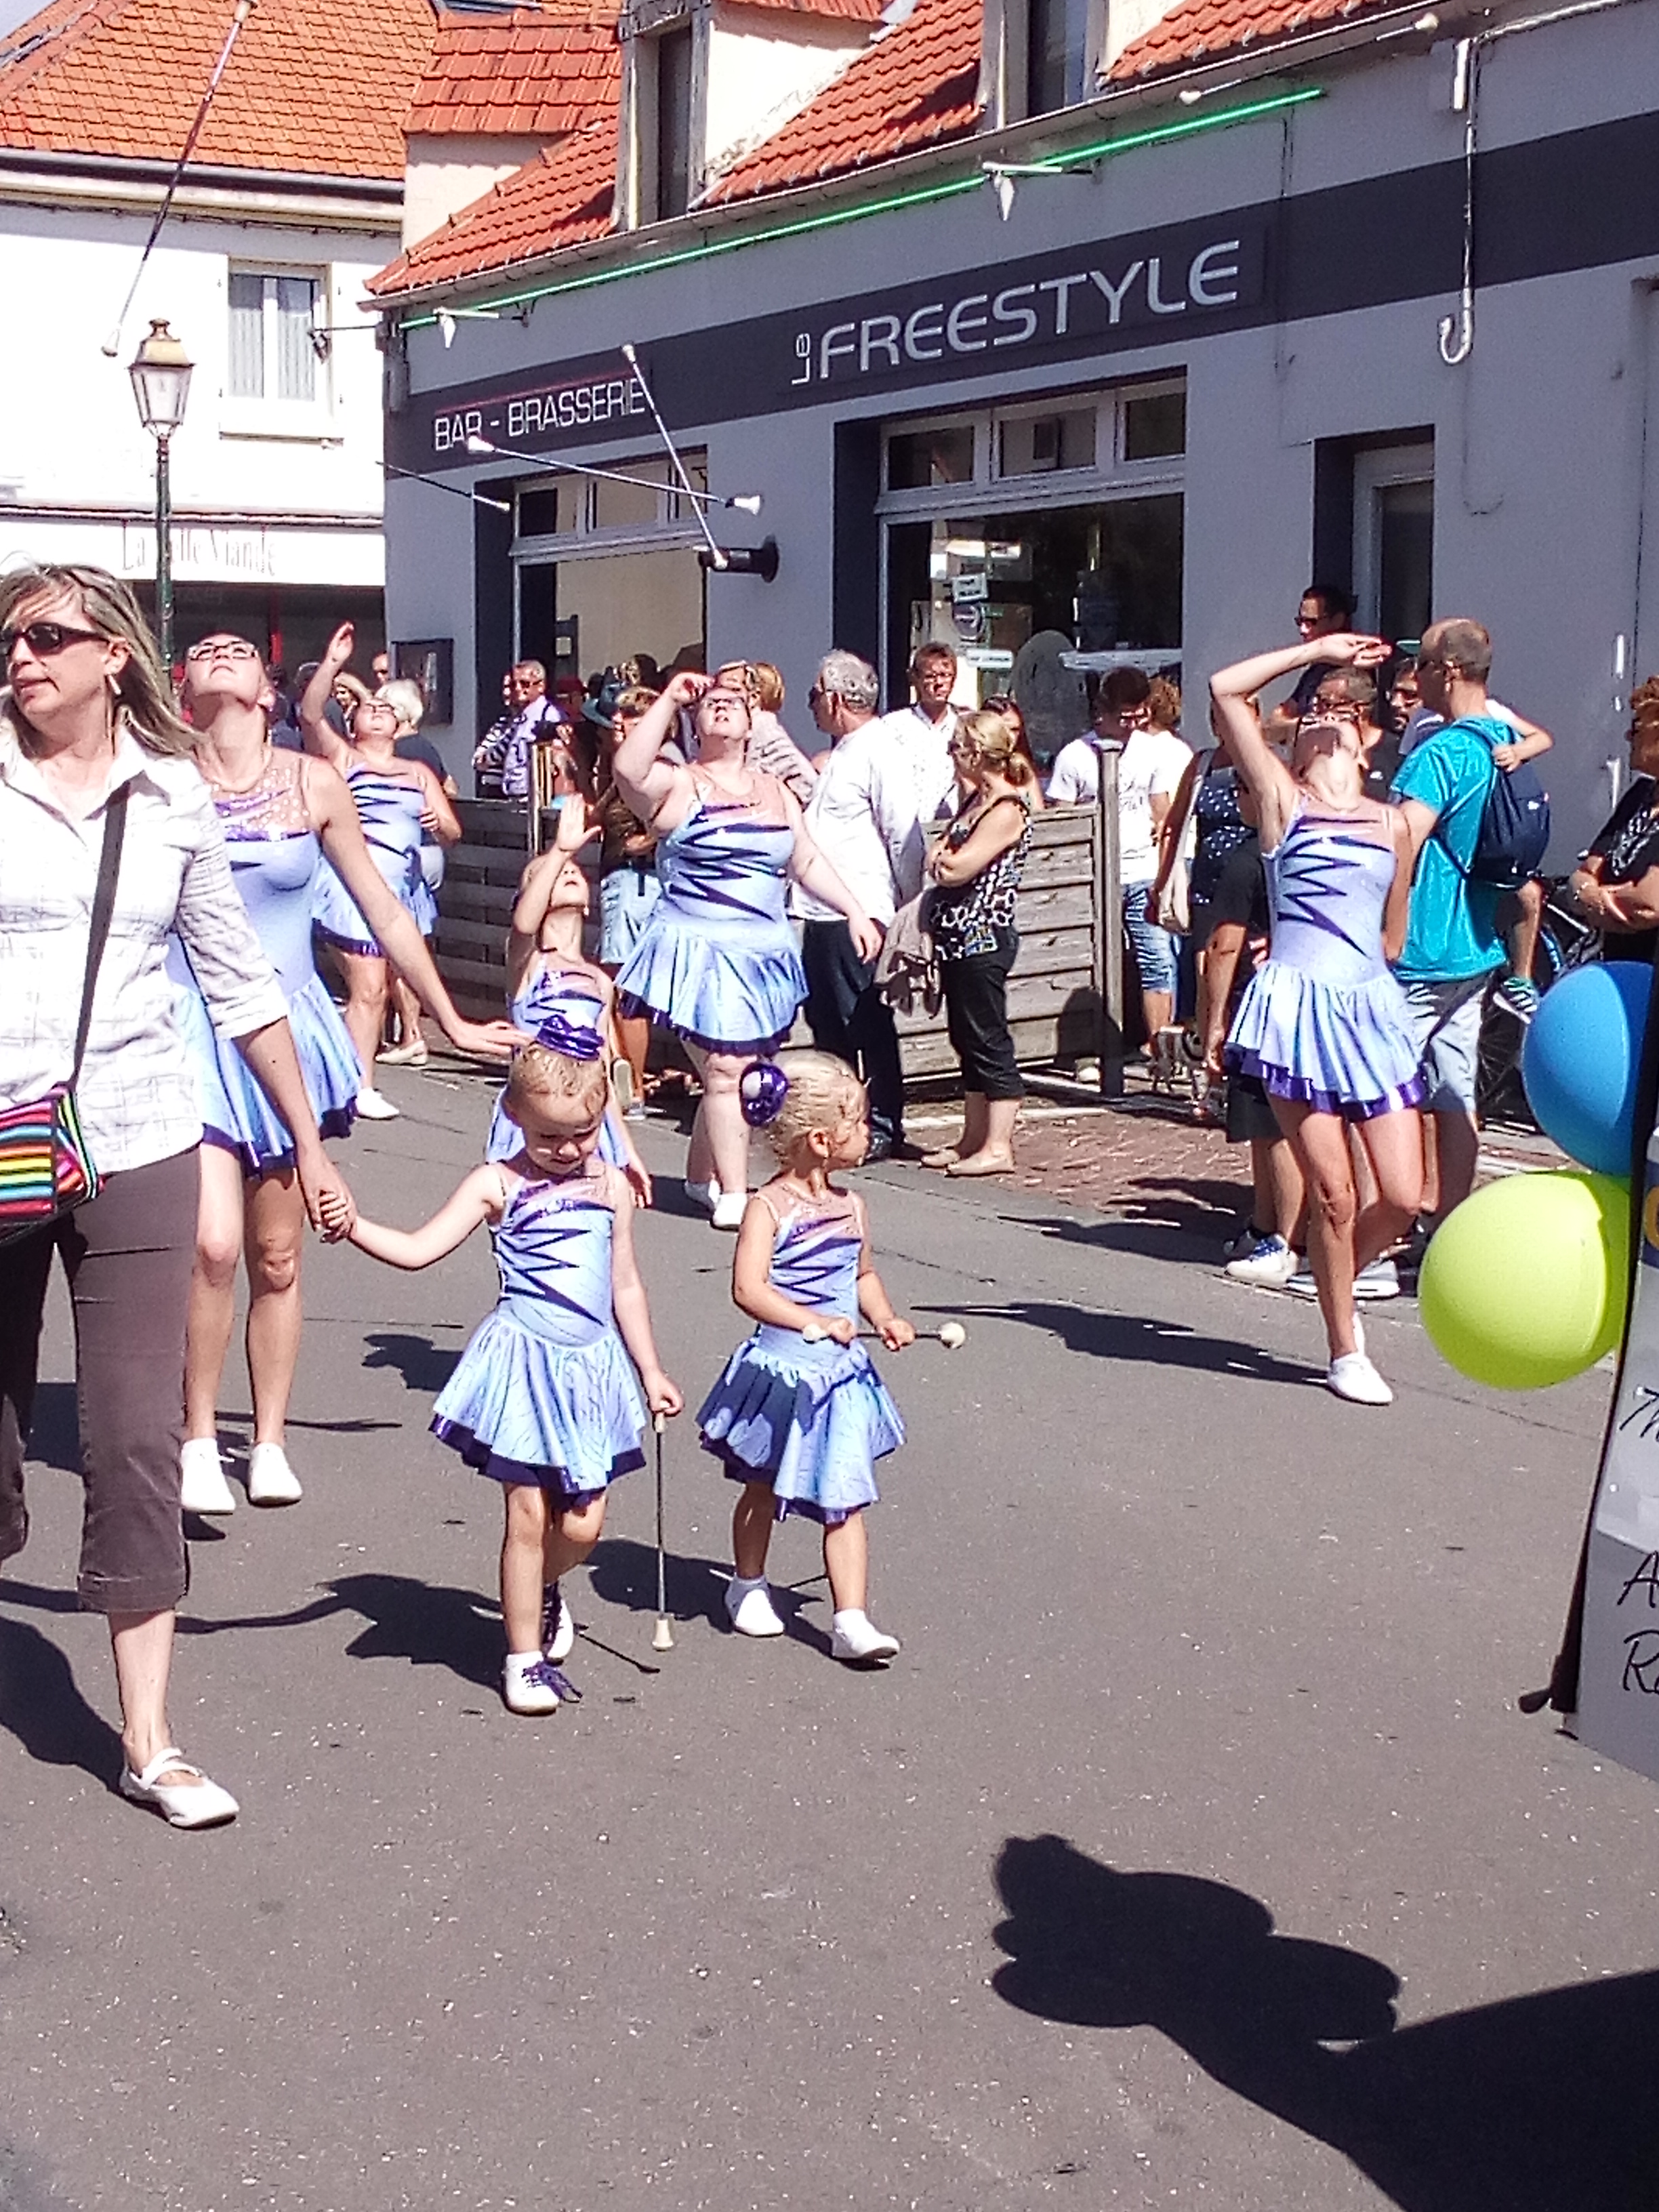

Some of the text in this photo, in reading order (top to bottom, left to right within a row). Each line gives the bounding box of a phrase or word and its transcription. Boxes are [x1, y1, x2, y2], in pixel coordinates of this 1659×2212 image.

[820, 239, 1240, 379] FREESTYLE
[434, 411, 483, 451] BAR
[508, 377, 646, 437] BRASSERIE
[121, 520, 146, 571] La
